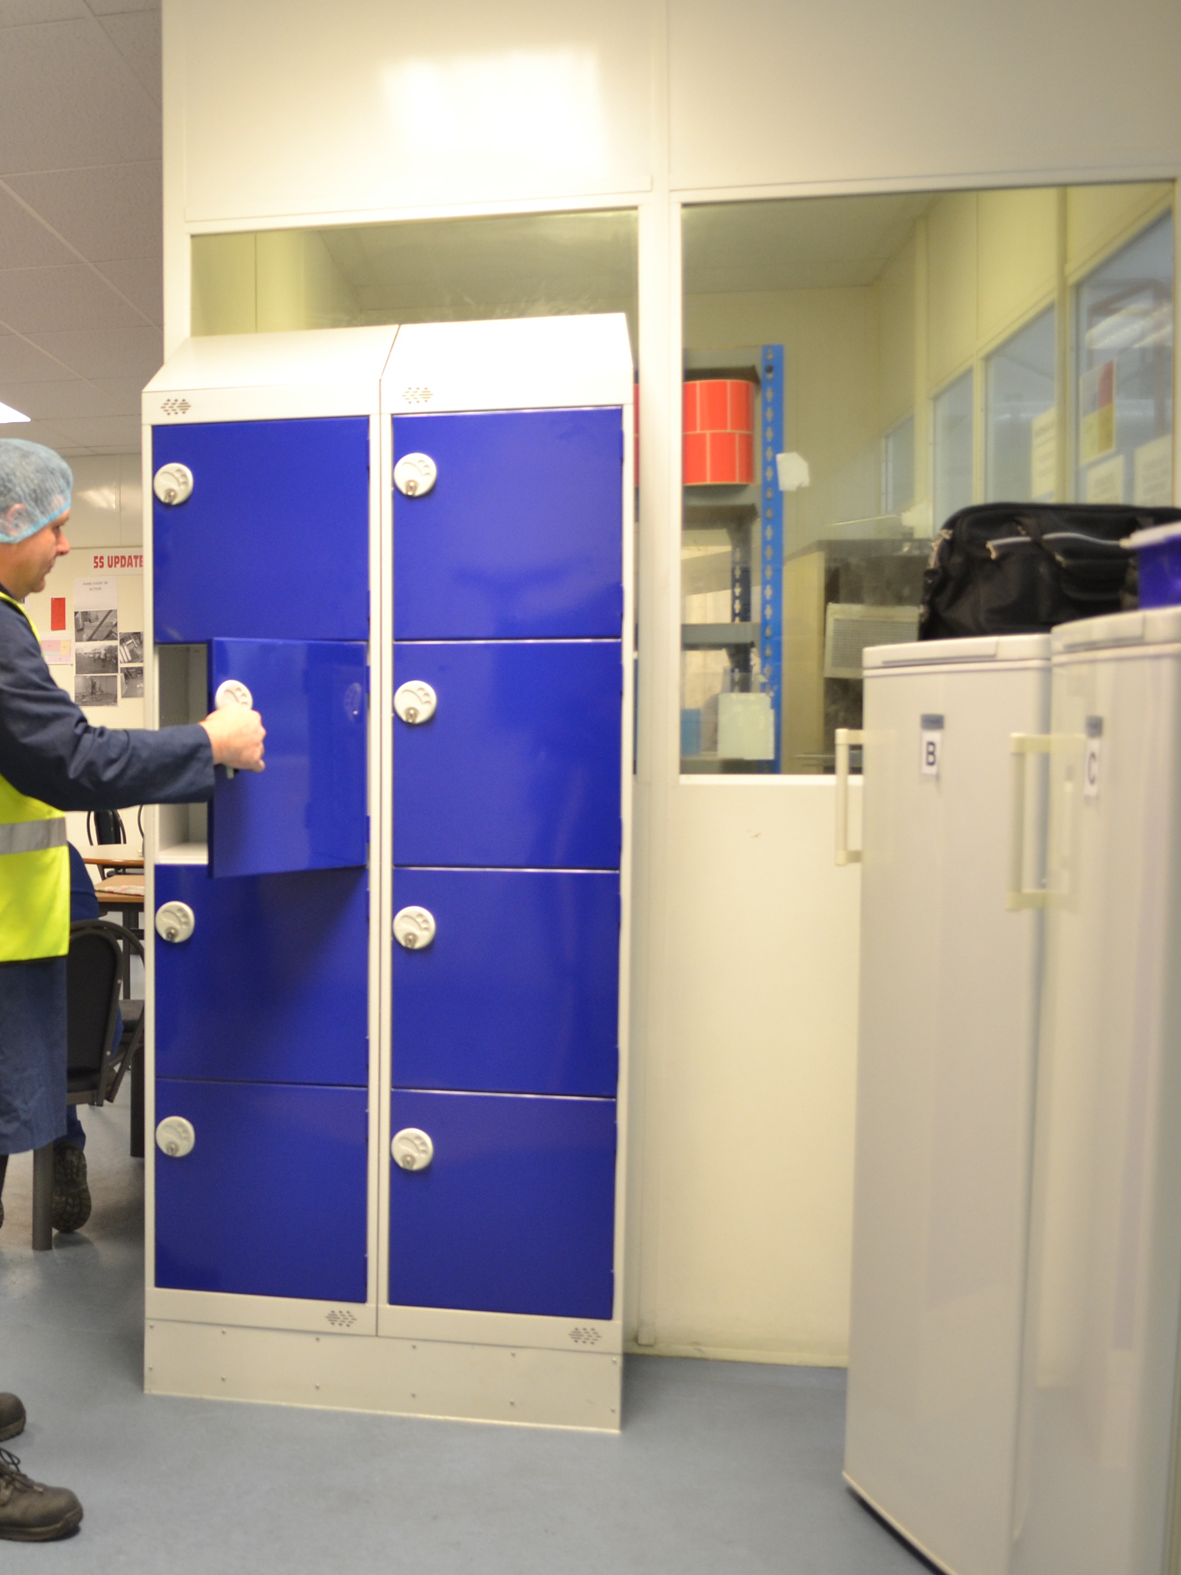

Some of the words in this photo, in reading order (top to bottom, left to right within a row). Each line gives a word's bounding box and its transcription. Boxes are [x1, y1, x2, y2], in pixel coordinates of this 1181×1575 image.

[93, 556, 104, 569] 5S
[926, 741, 936, 766] B
[1087, 751, 1097, 786] C
